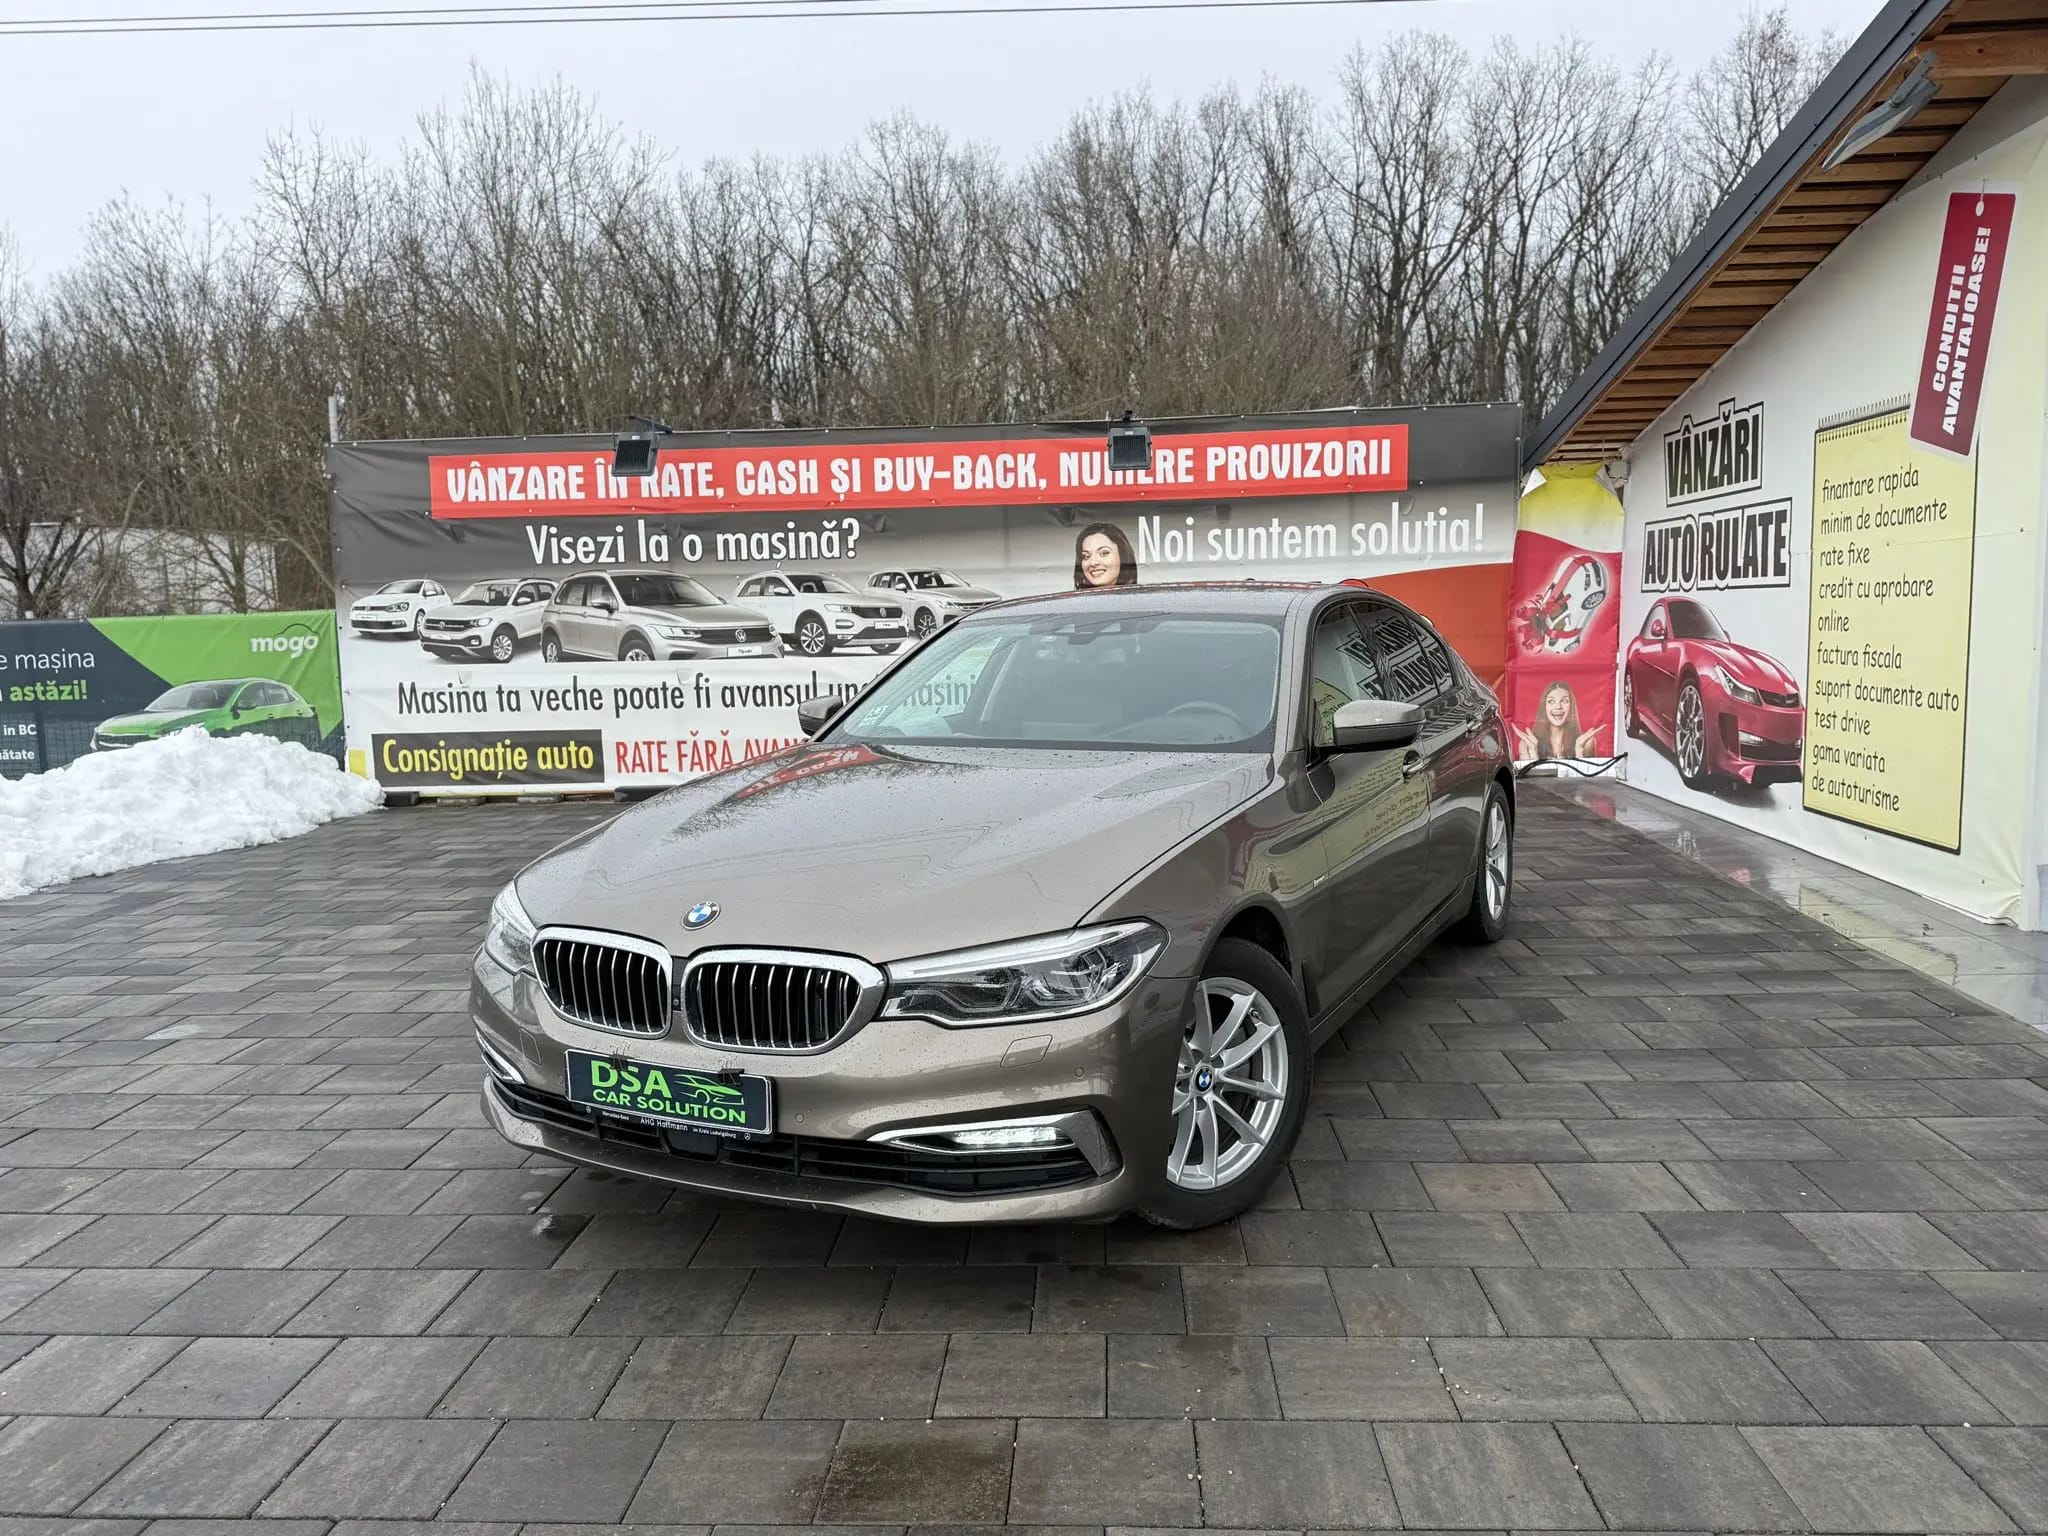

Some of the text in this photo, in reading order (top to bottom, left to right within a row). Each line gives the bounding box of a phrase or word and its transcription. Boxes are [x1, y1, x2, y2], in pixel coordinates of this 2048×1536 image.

[1932, 264, 1966, 392] CONDITII
[1942, 227, 1991, 436] AVANTAJOASE!
[447, 461, 585, 502] VÂNZARE
[594, 457, 629, 499] ÎN
[641, 462, 724, 499] RATE,
[736, 459, 818, 496] CASH
[830, 457, 861, 502] ȘI
[873, 453, 1047, 492] BUY-BACK,
[1206, 439, 1391, 481] PROVIZORII
[1667, 409, 1760, 498] VÂNZĂRI
[1822, 462, 1919, 503] finantare rapida
[1821, 498, 1948, 535] minim de documente
[526, 524, 625, 564] Visezi
[637, 519, 669, 563] la
[682, 533, 703, 562] o
[1138, 515, 1194, 563] Noi
[1207, 518, 1337, 562] suntem
[1645, 510, 1787, 584] AUTO RULATE
[1820, 542, 1870, 566] rate fixe
[1819, 573, 1934, 605] credit cu aprobare
[1818, 609, 1850, 632] online
[15, 648, 95, 674] mașina
[250, 636, 319, 659] mogo
[1817, 641, 1902, 669] factura fiscala
[10, 680, 88, 701] astăzi!
[496, 684, 521, 712] ta
[531, 675, 603, 712] veche
[613, 681, 684, 718] poate
[694, 672, 711, 709] fi
[721, 670, 818, 708] avansul
[1815, 678, 1959, 712] suport documente auto
[19, 724, 37, 735] BC
[1815, 709, 1871, 735] test drive
[0, 749, 35, 760] ătate
[382, 739, 594, 780] Consignație auto
[615, 740, 669, 774] RATE
[677, 730, 733, 773] FĂRĂ
[1813, 744, 1885, 773] gama variata
[1812, 770, 1900, 811] de autoturisme
[591, 1060, 672, 1098] DSA
[592, 1089, 746, 1123] CAR SOLUTION
